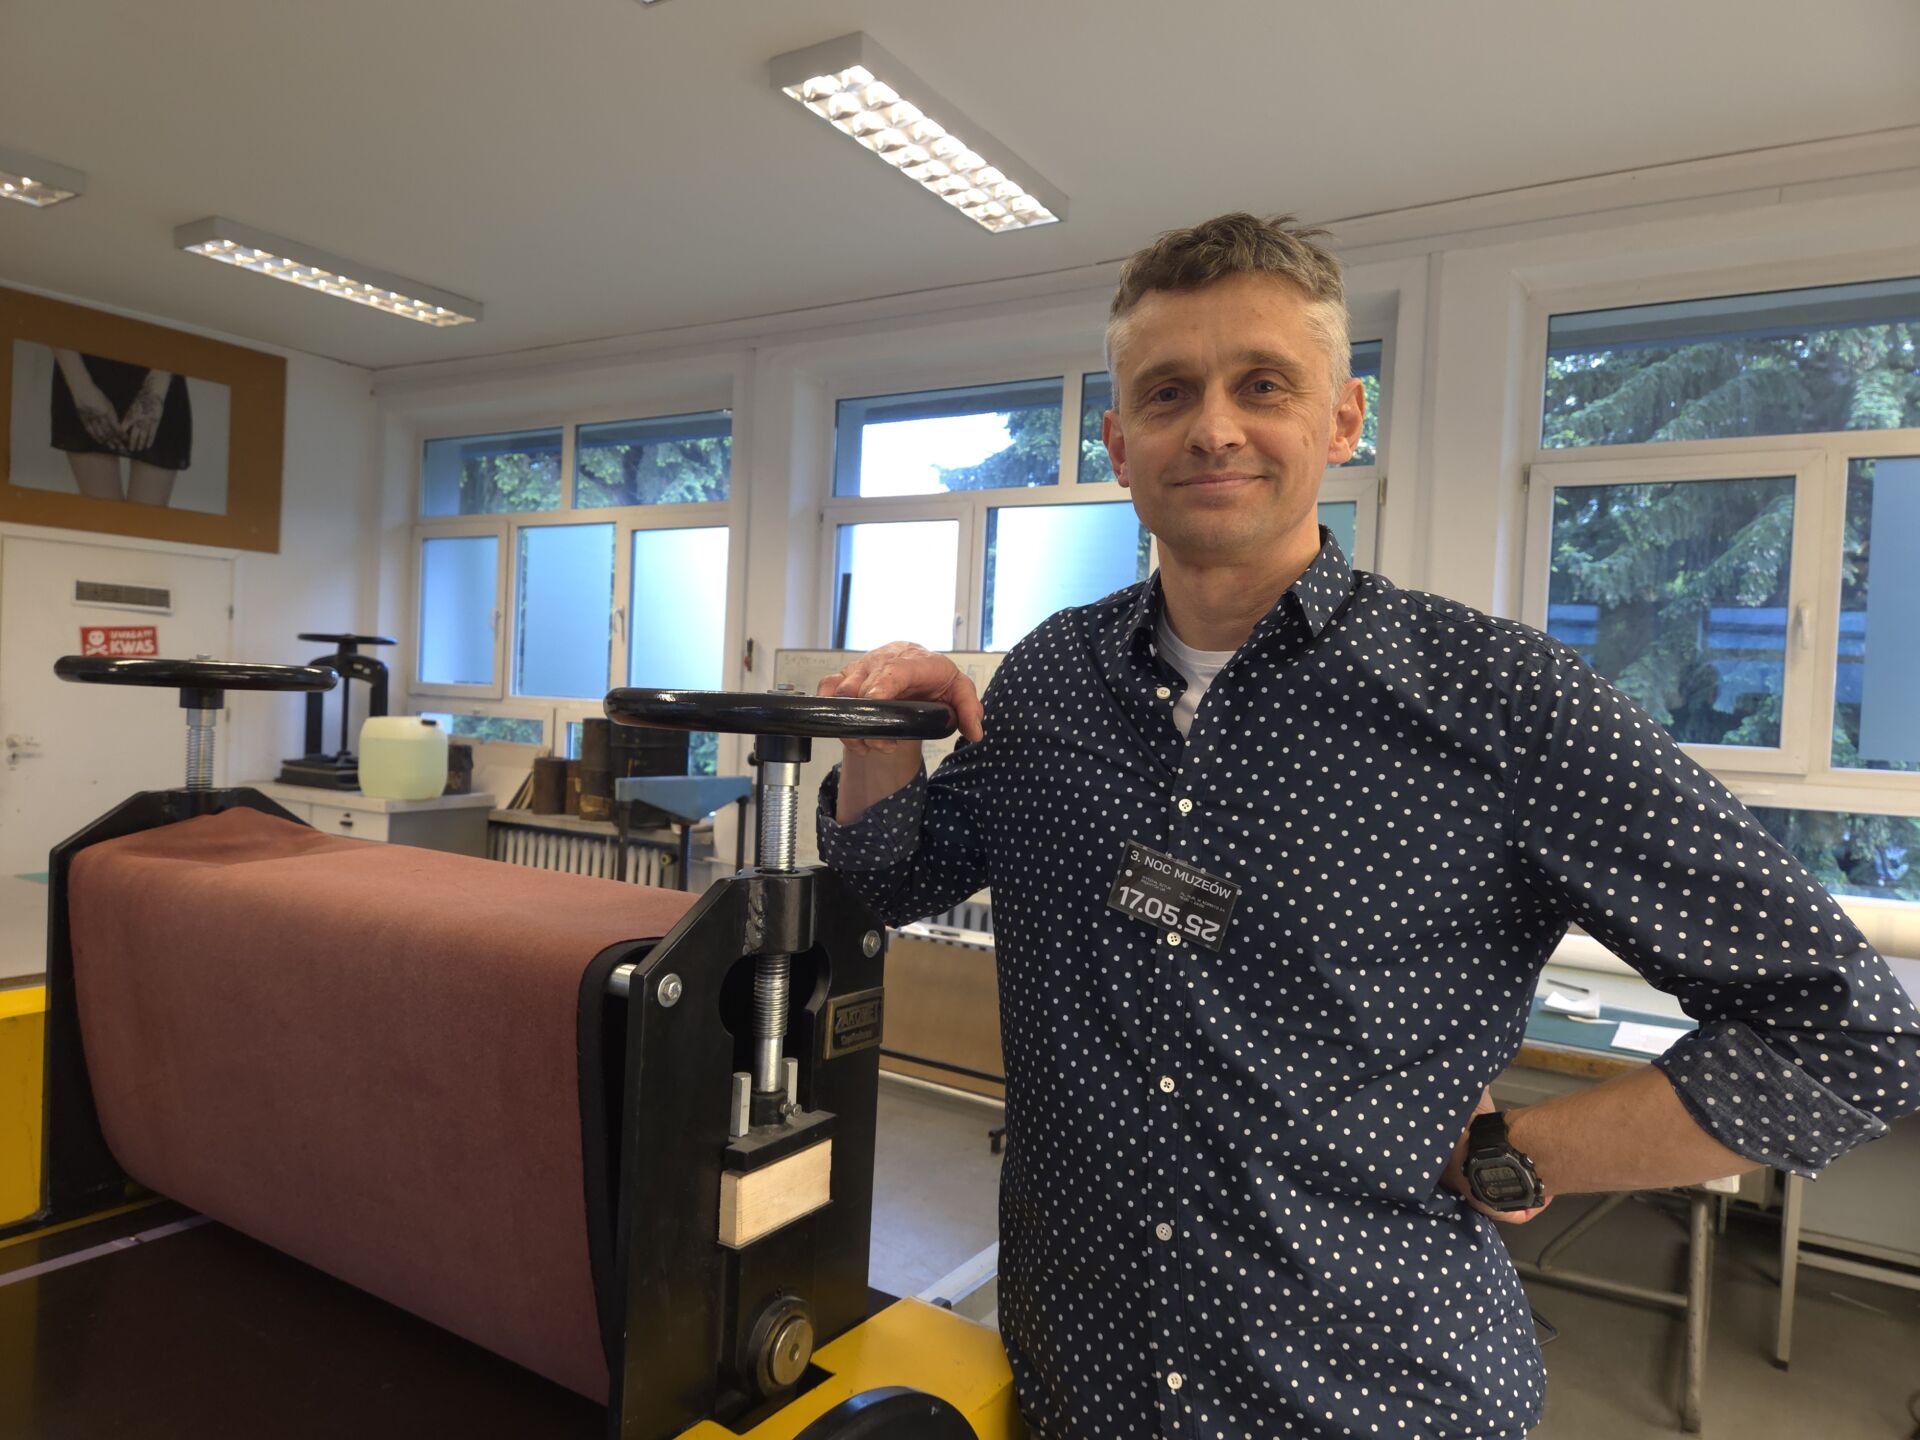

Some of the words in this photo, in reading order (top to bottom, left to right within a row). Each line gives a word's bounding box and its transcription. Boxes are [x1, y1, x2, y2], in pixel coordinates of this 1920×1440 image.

[110, 640, 155, 654] KWAS
[1130, 850, 1141, 863] 3.
[1144, 856, 1172, 875] NOC
[1174, 868, 1231, 899] MUZEÓW
